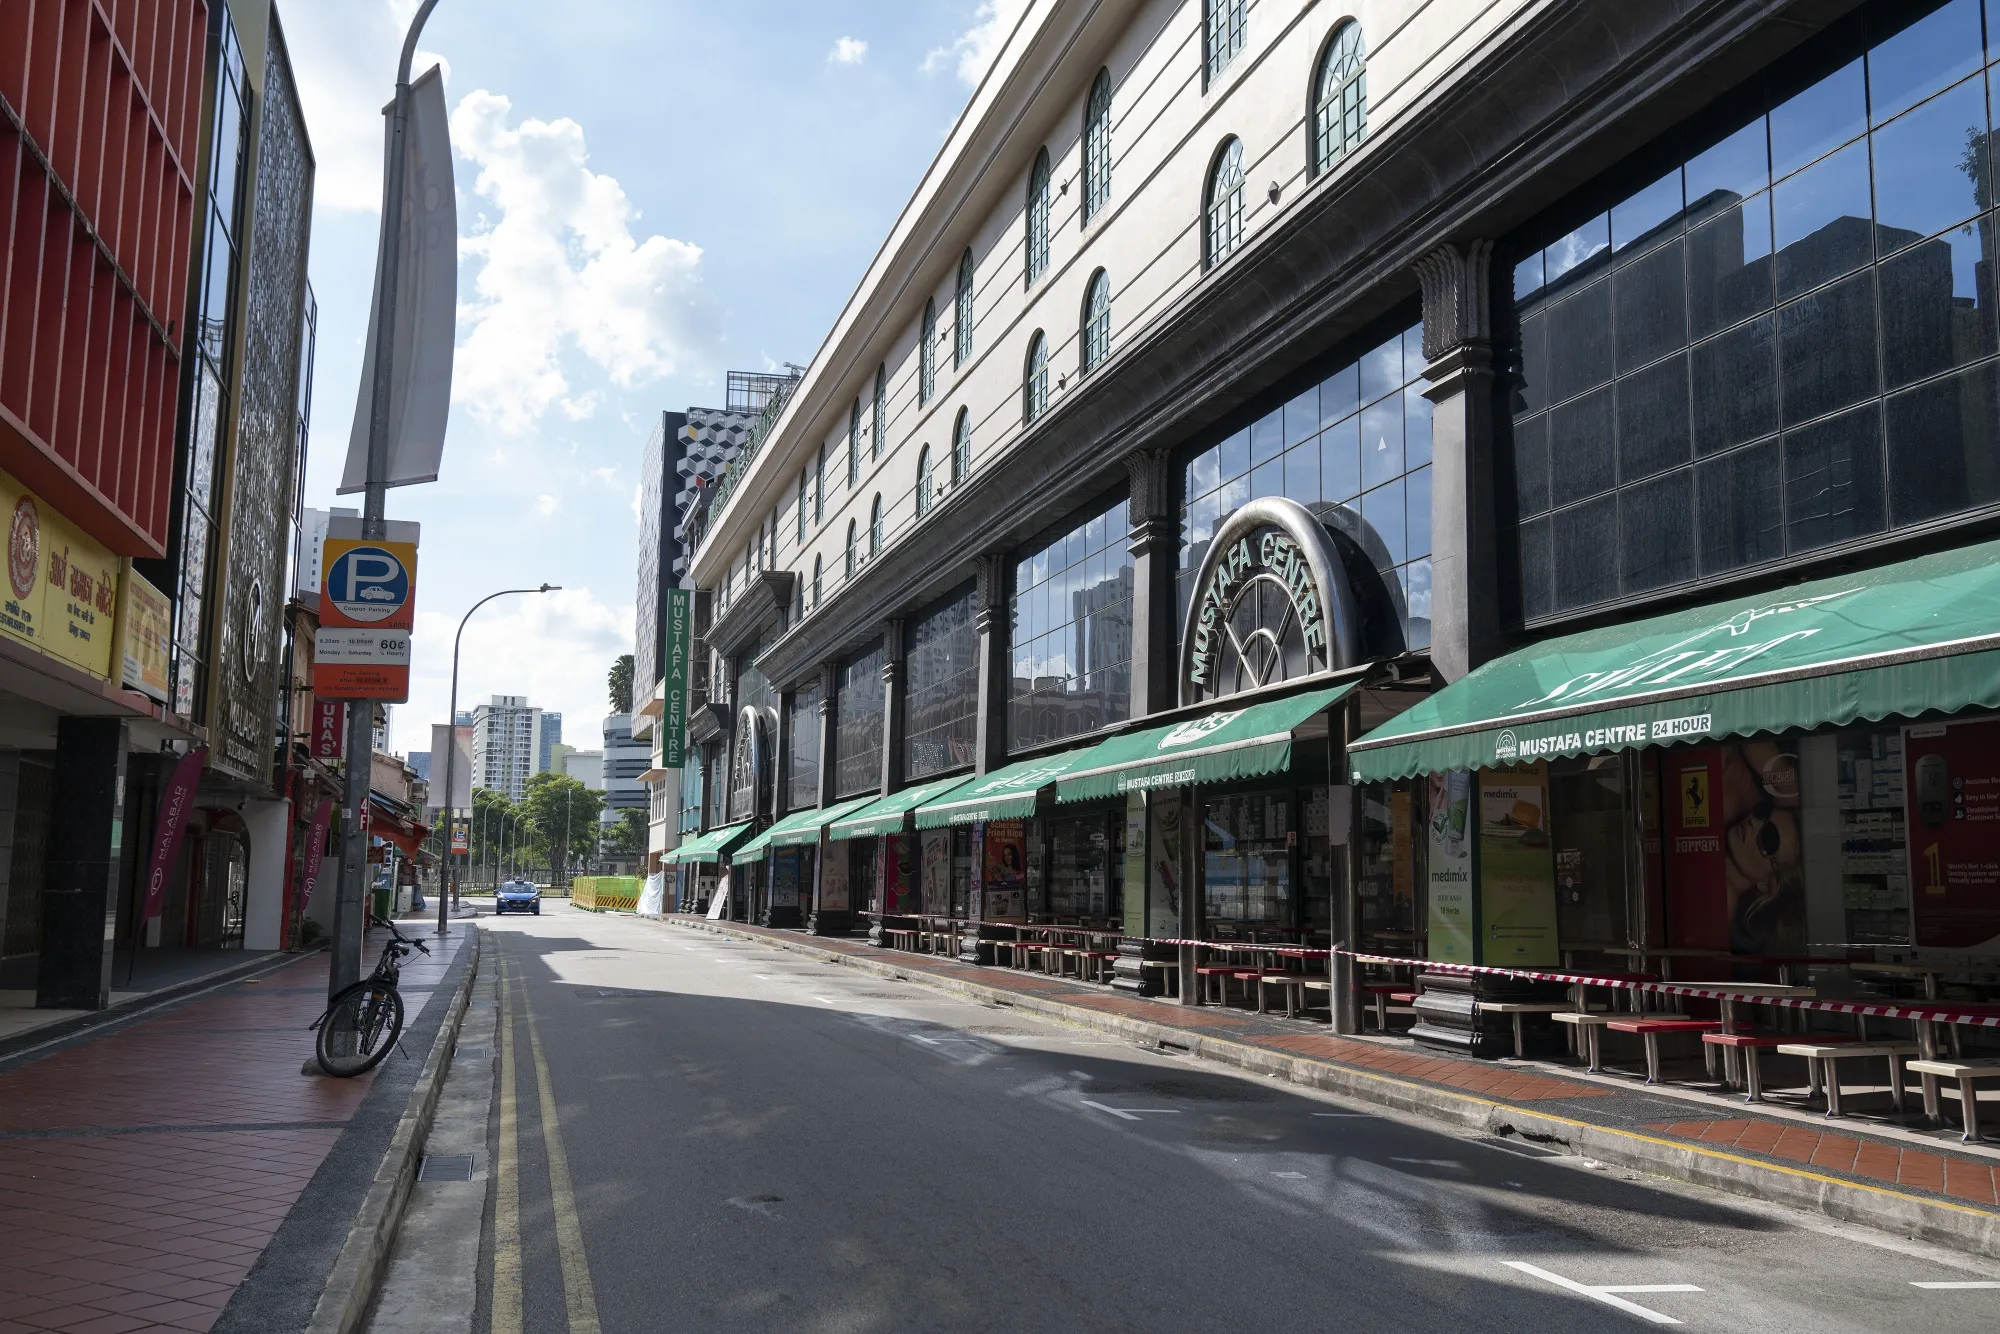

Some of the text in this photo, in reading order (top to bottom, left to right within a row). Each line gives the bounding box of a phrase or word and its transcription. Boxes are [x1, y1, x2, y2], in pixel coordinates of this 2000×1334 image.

[346, 554, 399, 601] P
[343, 605, 391, 614] Coupon Parking
[1191, 533, 1326, 685] MUSTAFA CENTRE
[319, 649, 341, 657] Monday
[381, 639, 405, 650] 60¢
[668, 594, 685, 764] MUSTAFA CENTRE
[321, 700, 337, 757] URA'S
[1518, 716, 1711, 757] MUSTAFA CENTRE 24 HOUR
[1127, 777, 1151, 790] MUSTAFA
[1151, 773, 1174, 786] CENTRE
[1483, 788, 1518, 800] medimix
[159, 785, 183, 860] MALABAR
[987, 829, 1024, 838] Fried Rice
[1675, 835, 1720, 853] Ferrari
[1431, 867, 1468, 883] medimix
